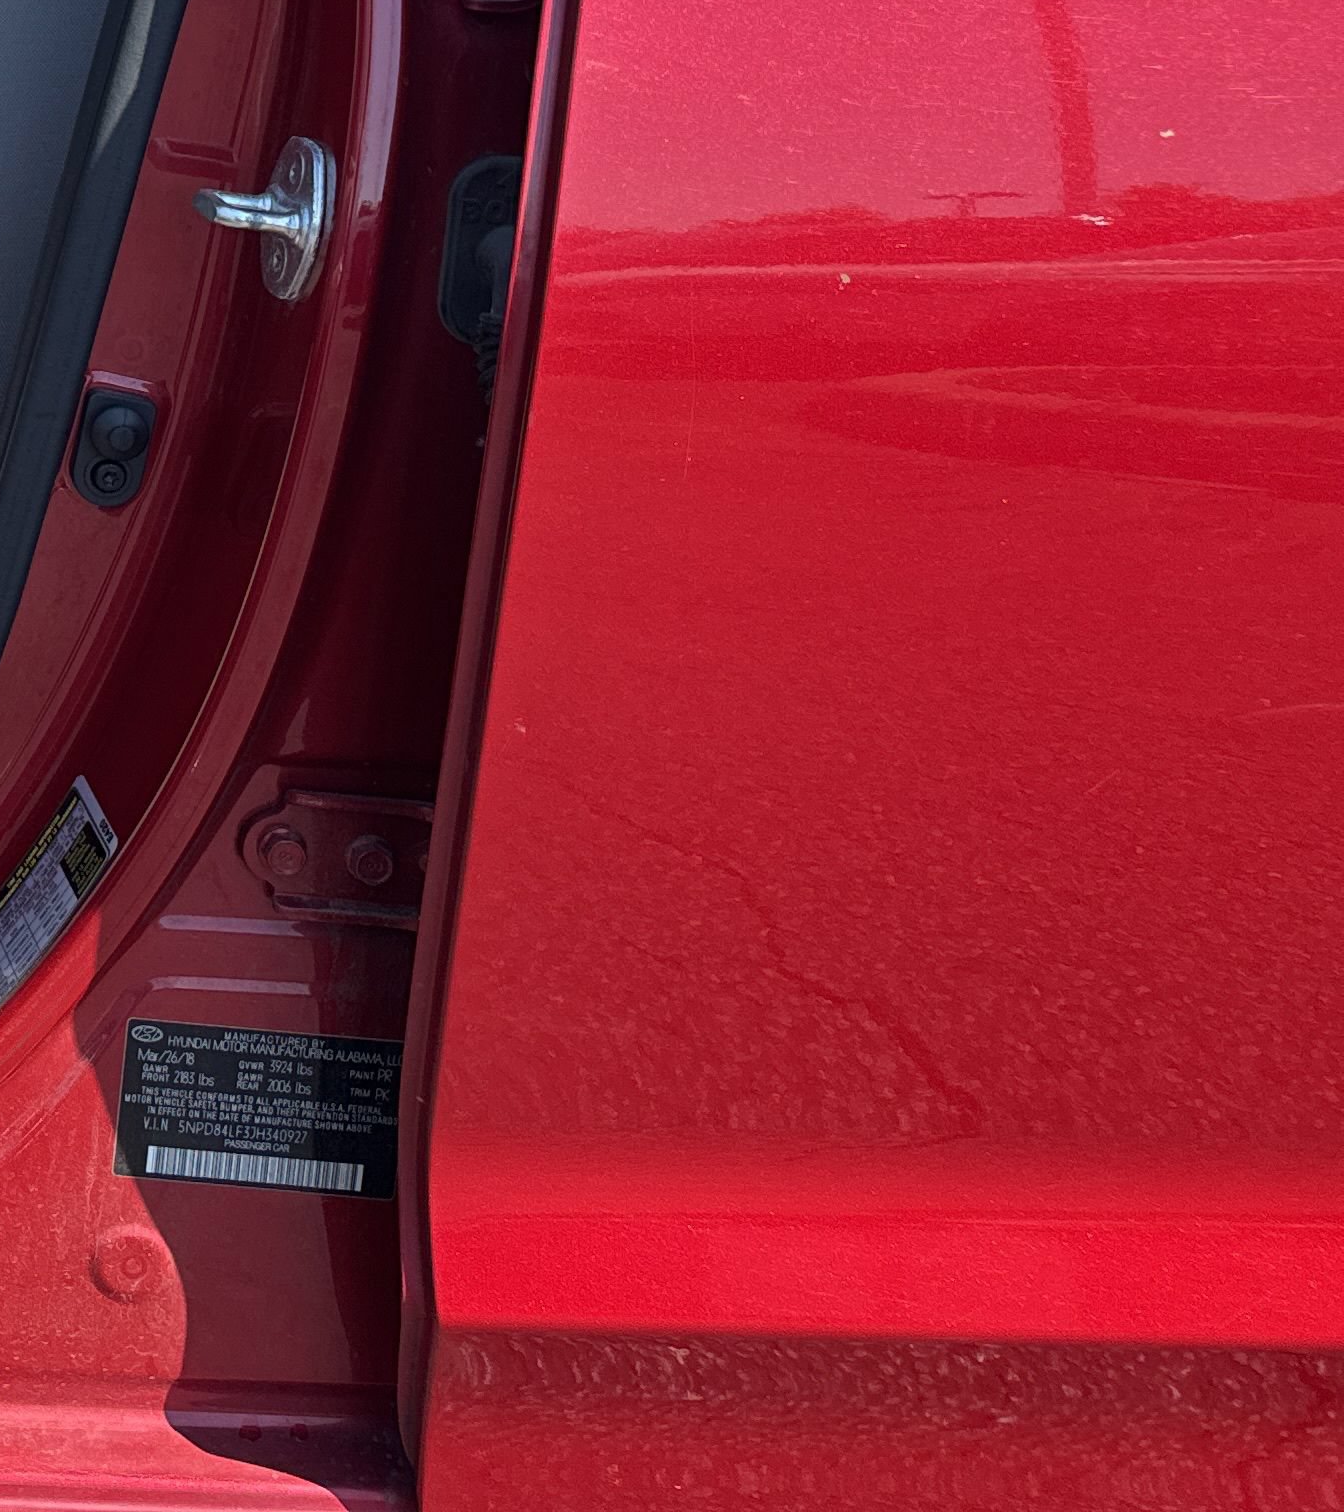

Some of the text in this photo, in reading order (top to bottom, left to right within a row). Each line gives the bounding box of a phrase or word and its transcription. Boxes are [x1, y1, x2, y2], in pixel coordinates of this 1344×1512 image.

[224, 1031, 324, 1048] MANUFACTURED BY
[137, 1048, 195, 1065] Mar/26/18
[167, 1035, 211, 1050] HYUNDAI
[212, 1039, 249, 1053] MOTOR
[249, 1042, 333, 1060] MANUFACTURING
[335, 1049, 385, 1065] ALABAMA,
[142, 1063, 168, 1073] GAWR
[238, 1059, 313, 1075] GVWR 3924 lbs
[349, 1070, 374, 1079] PAINT
[141, 1071, 215, 1086] FRONT 2183 lbs
[237, 1071, 263, 1081] GAWR
[236, 1079, 312, 1095] REAR 2006 lbs
[349, 1088, 370, 1098] TRIM
[124, 1093, 152, 1104] MOTOR
[154, 1096, 186, 1107] VEHICLE
[256, 1105, 274, 1115] AND
[276, 1107, 299, 1117] THEFT
[301, 1109, 348, 1121] PREVENTION
[141, 1086, 159, 1095] THIS
[161, 1088, 193, 1098] VEHICLE
[195, 1091, 241, 1102] CONFORMS
[243, 1095, 254, 1103] TO
[256, 1096, 271, 1105] ALL
[273, 1097, 320, 1109] APPLICABLE
[347, 1104, 381, 1115] FEDERAL
[147, 1105, 372, 1133] IN EFFECT ON THE DATE OF MANUFACTURE SHOWN ABOVE
[224, 1138, 289, 1152] PASSENGER CAR
